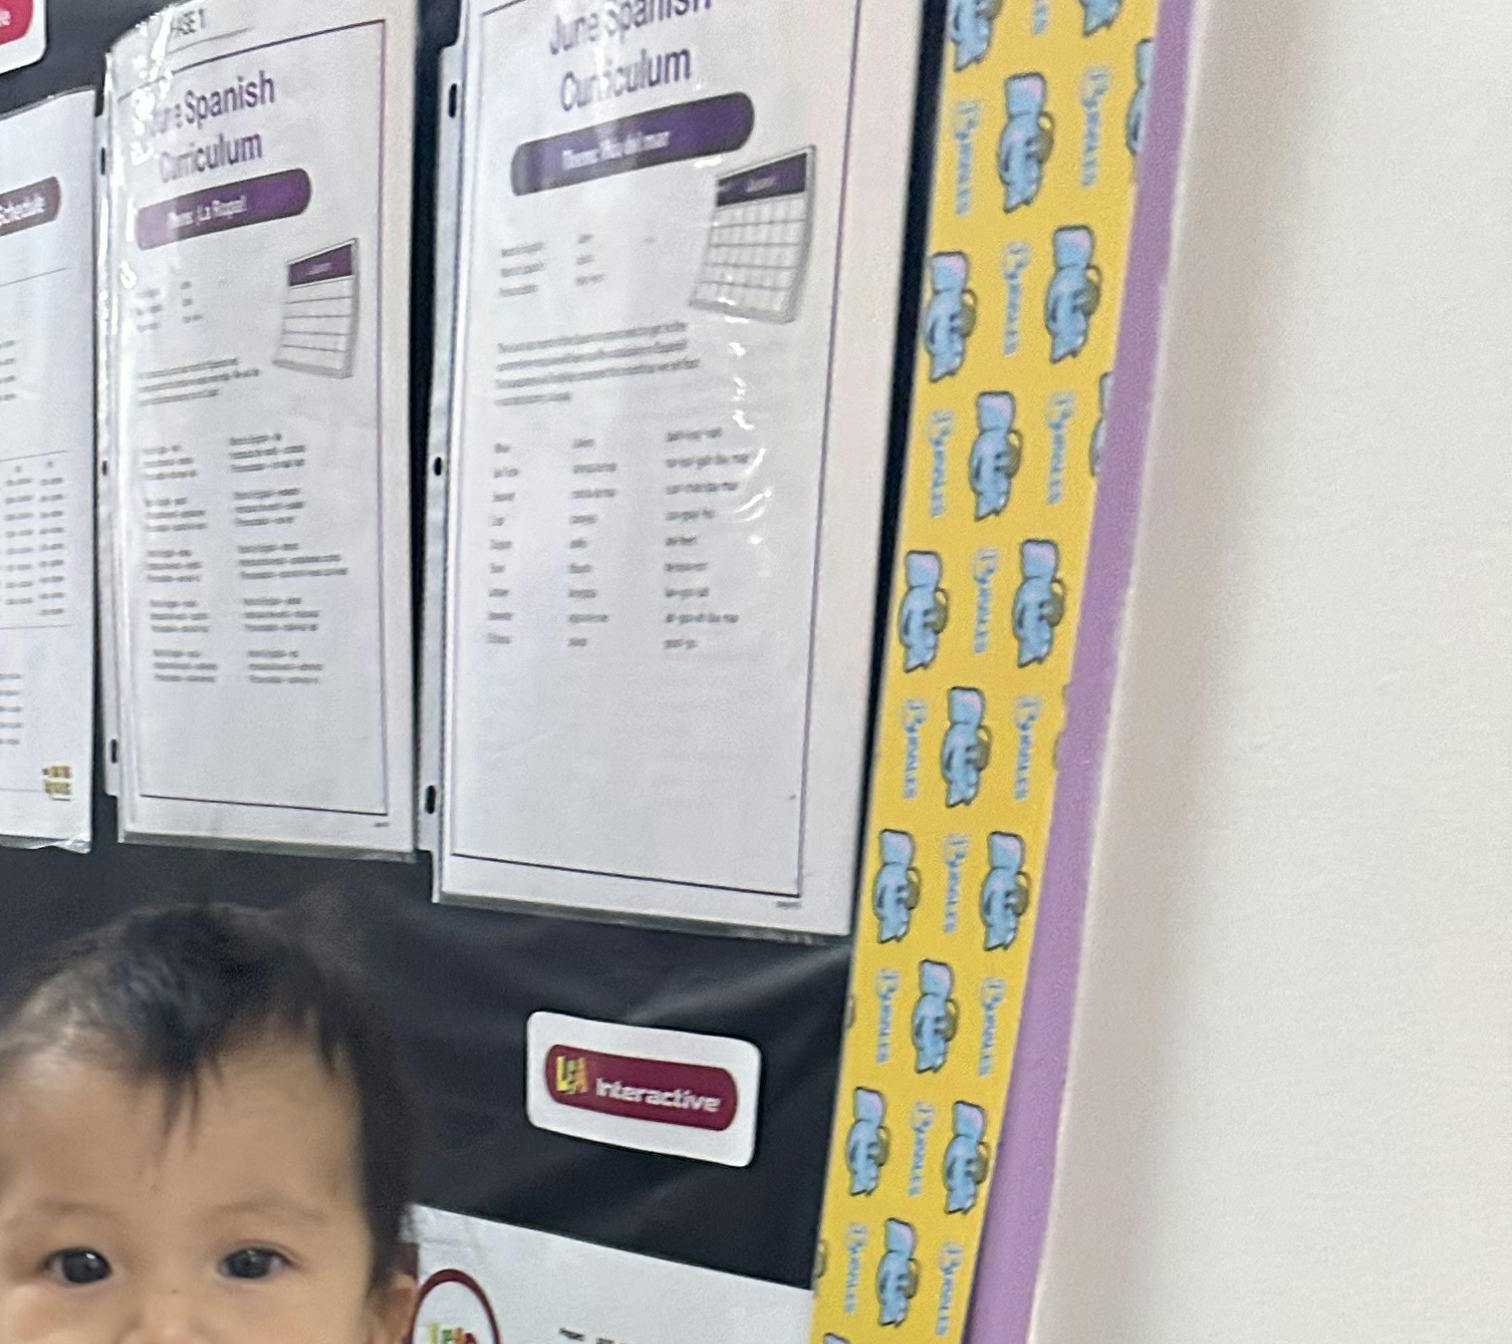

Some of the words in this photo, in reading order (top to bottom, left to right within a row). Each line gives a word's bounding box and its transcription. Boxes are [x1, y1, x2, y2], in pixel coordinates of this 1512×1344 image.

[184, 69, 276, 129] Spanish
[560, 48, 692, 112] Curriculum
[595, 1078, 722, 1113] Interactive
